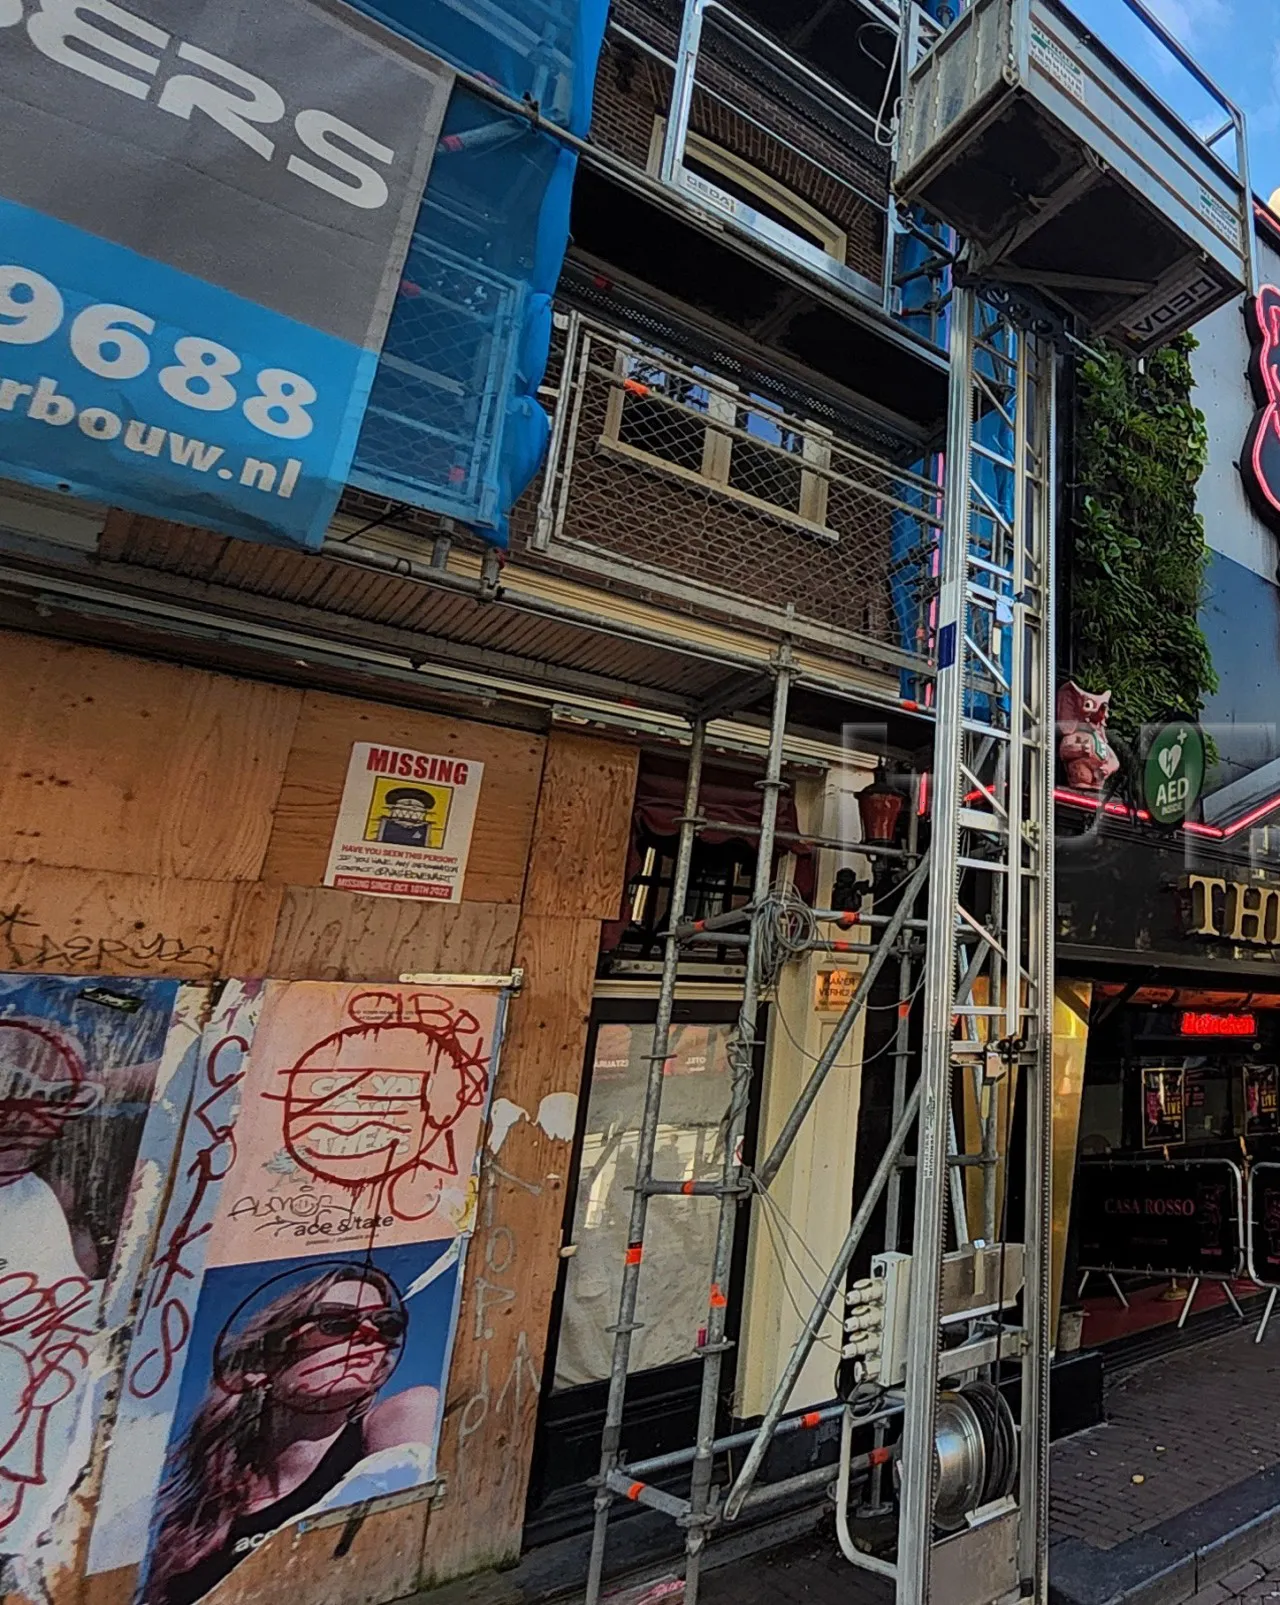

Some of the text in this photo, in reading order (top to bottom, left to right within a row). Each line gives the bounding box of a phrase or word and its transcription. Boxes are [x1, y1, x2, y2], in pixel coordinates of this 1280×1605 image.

[366, 747, 469, 785] MISSING
[1155, 777, 1189, 806] AED
[364, 846, 382, 857] YOU
[404, 851, 423, 860] THIS
[371, 881, 392, 892] SINCE
[1182, 1012, 1254, 1034] Heineken
[1104, 1198, 1195, 1216] CASA ROSSO
